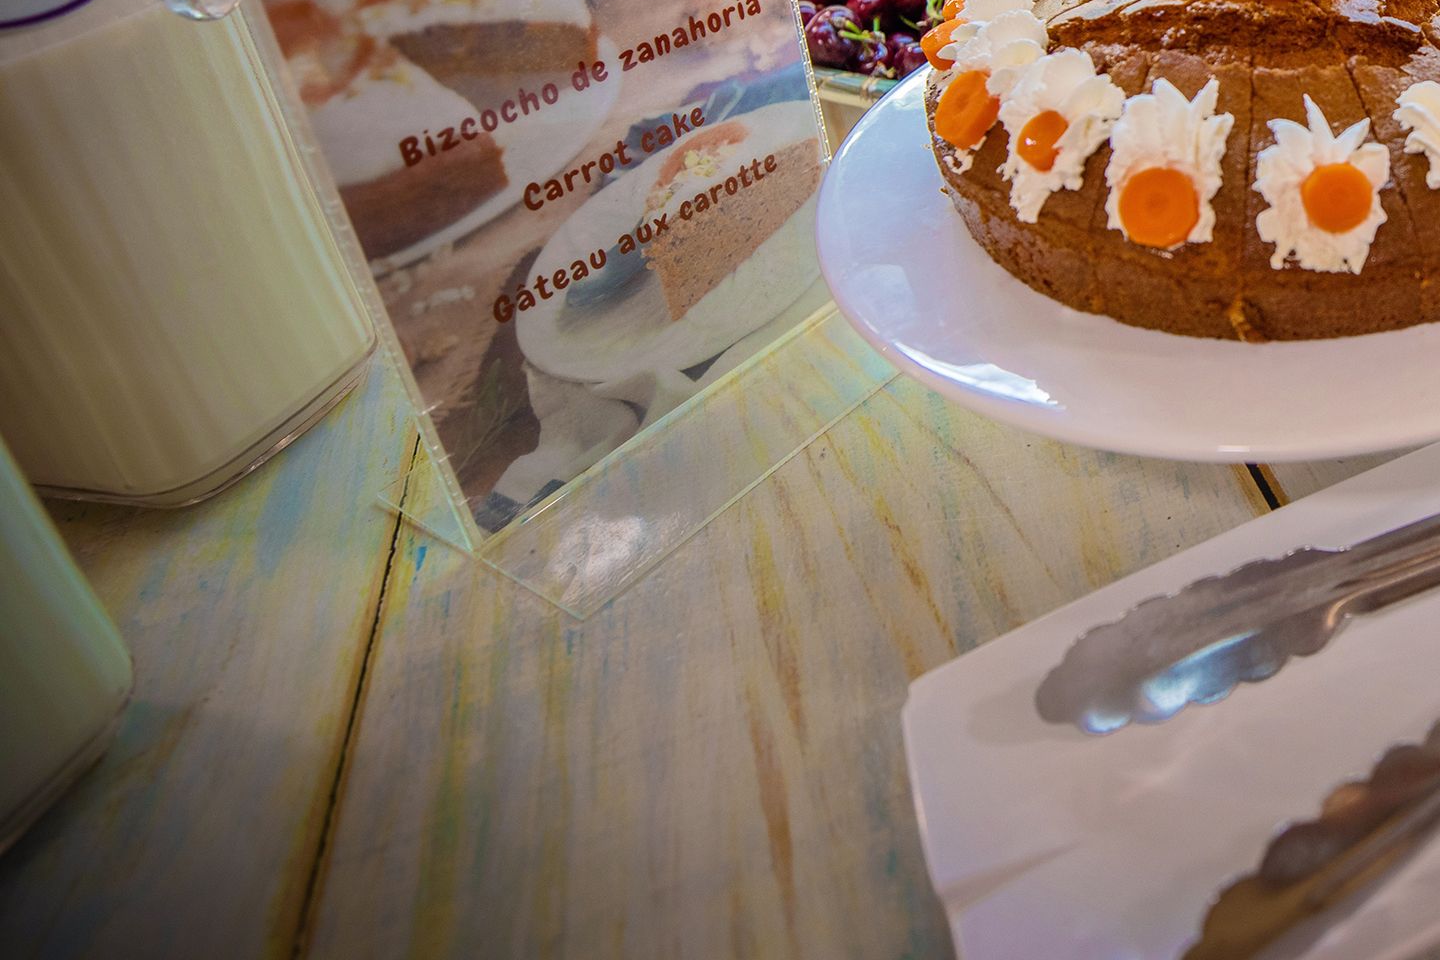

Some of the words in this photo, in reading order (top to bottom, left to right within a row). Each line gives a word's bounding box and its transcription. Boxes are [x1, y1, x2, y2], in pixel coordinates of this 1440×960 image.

[398, 84, 559, 168] Bizcocho
[571, 61, 609, 91] de
[523, 140, 633, 211] Carrot
[640, 106, 706, 153] cake
[492, 249, 607, 324] Gâteau
[618, 212, 669, 254] aux
[679, 152, 778, 221] carotte
